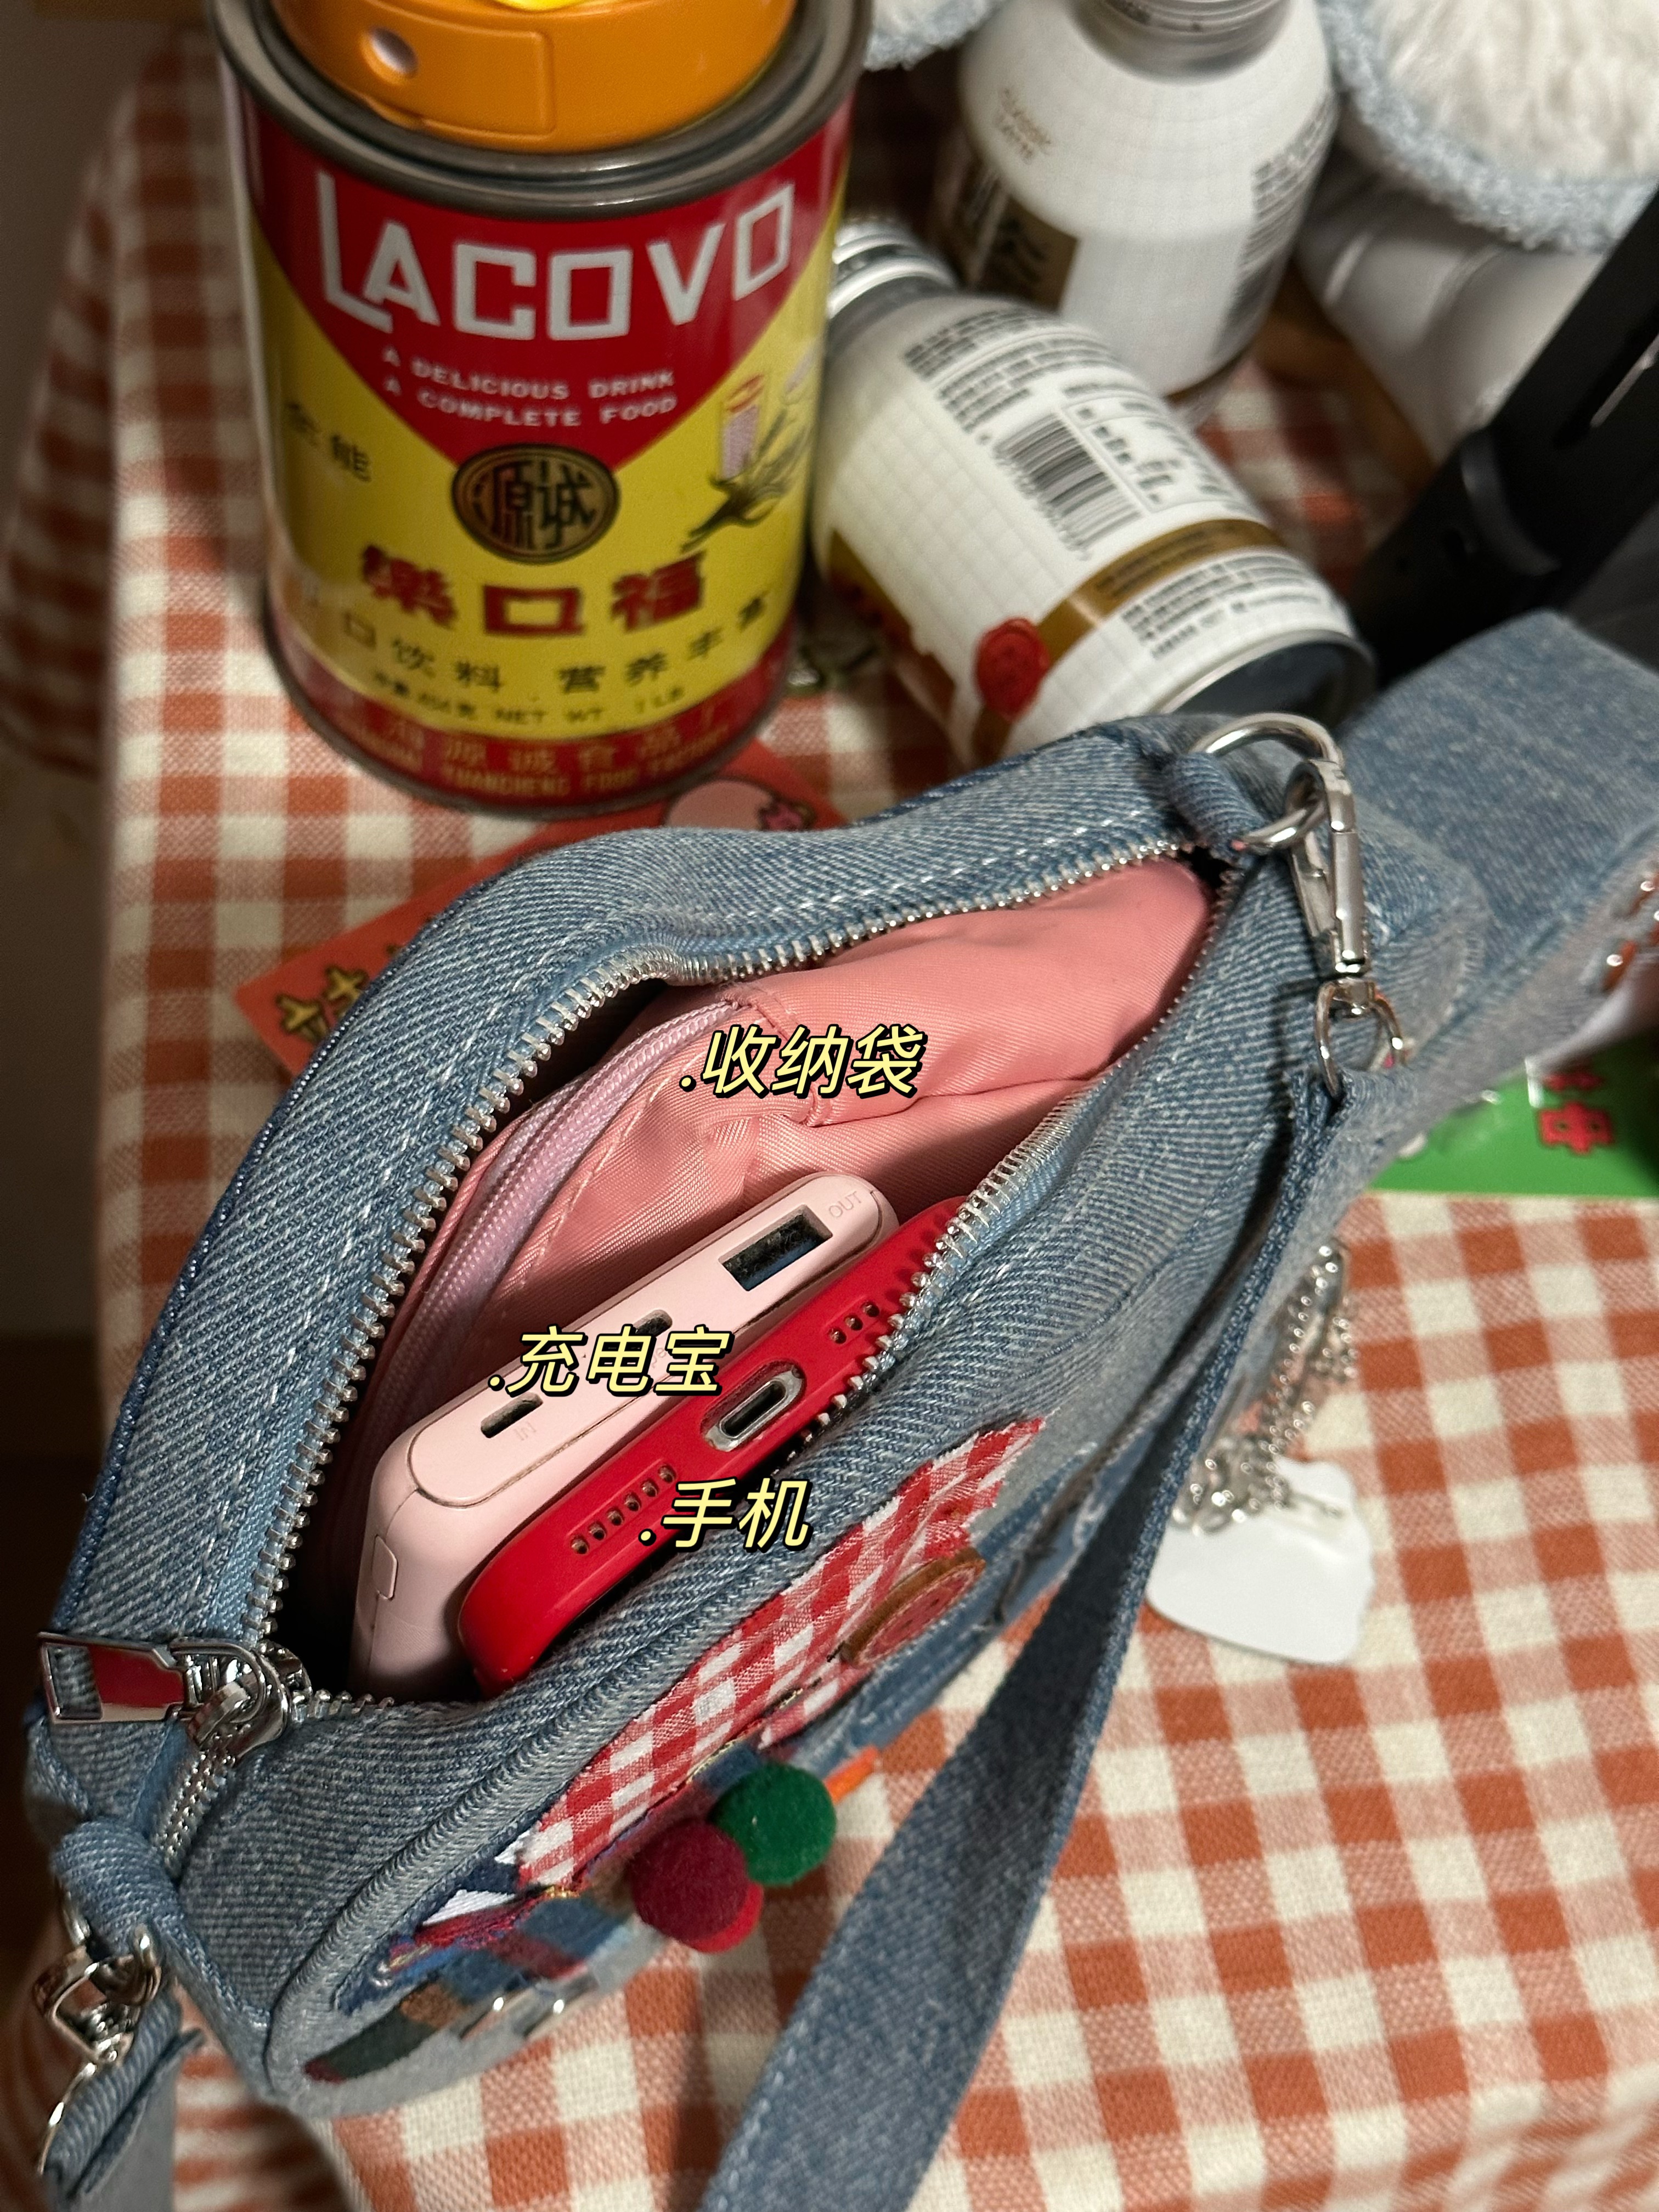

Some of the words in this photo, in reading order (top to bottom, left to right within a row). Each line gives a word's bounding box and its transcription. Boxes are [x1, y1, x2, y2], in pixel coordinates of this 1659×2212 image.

[317, 170, 795, 341] LACOVO
[382, 345, 401, 368] A
[410, 356, 570, 400] DELICIOUS
[588, 368, 675, 399] DRINK
[385, 373, 403, 396] A
[416, 385, 582, 427] COMPLETE
[600, 392, 678, 424] FOOD
[828, 1190, 862, 1218] OUT
